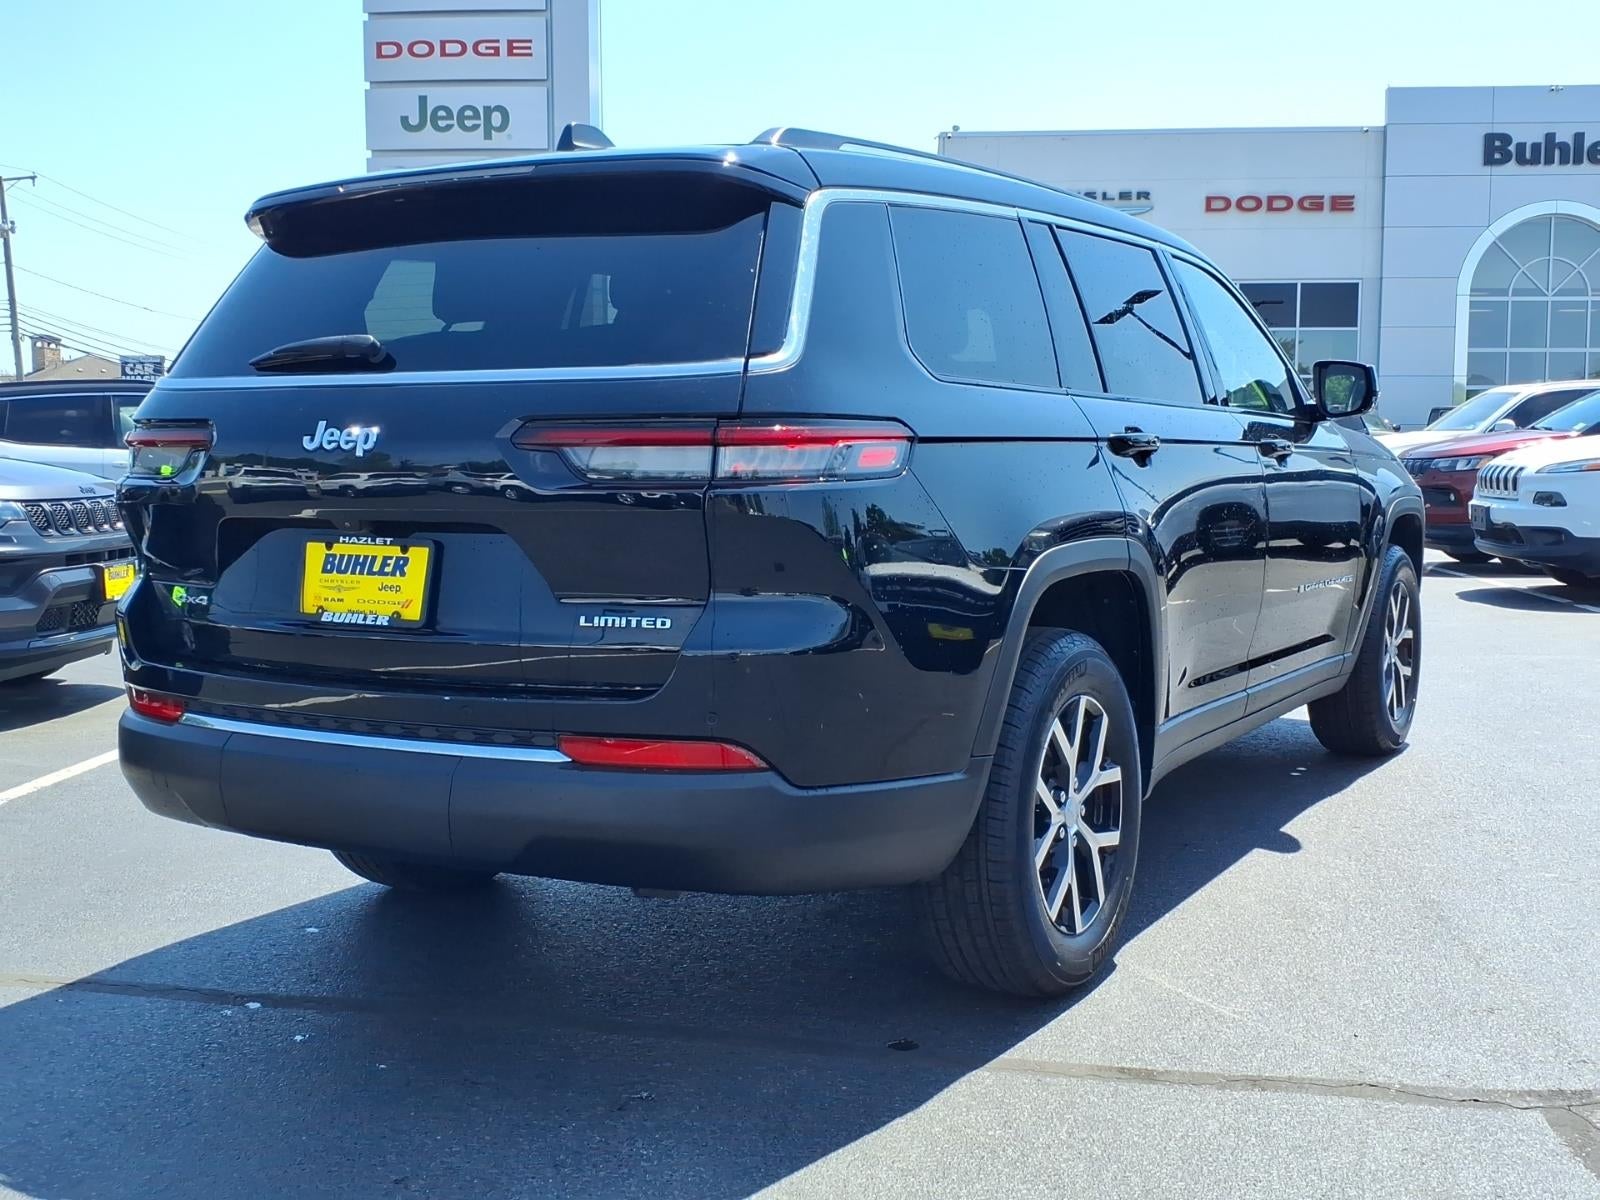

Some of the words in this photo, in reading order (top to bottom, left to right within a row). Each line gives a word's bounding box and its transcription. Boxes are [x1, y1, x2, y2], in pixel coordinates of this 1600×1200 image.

[375, 39, 533, 59] DODGE
[400, 95, 511, 140] Jeep
[1205, 195, 1355, 212] DODGE
[125, 363, 154, 375] CAR
[302, 420, 379, 457] Jeep
[339, 536, 393, 545] HAZLET
[321, 553, 409, 577] BUHLER
[378, 582, 401, 594] Jeep
[321, 612, 390, 626] BUHLER
[580, 615, 671, 629] LIMITED
